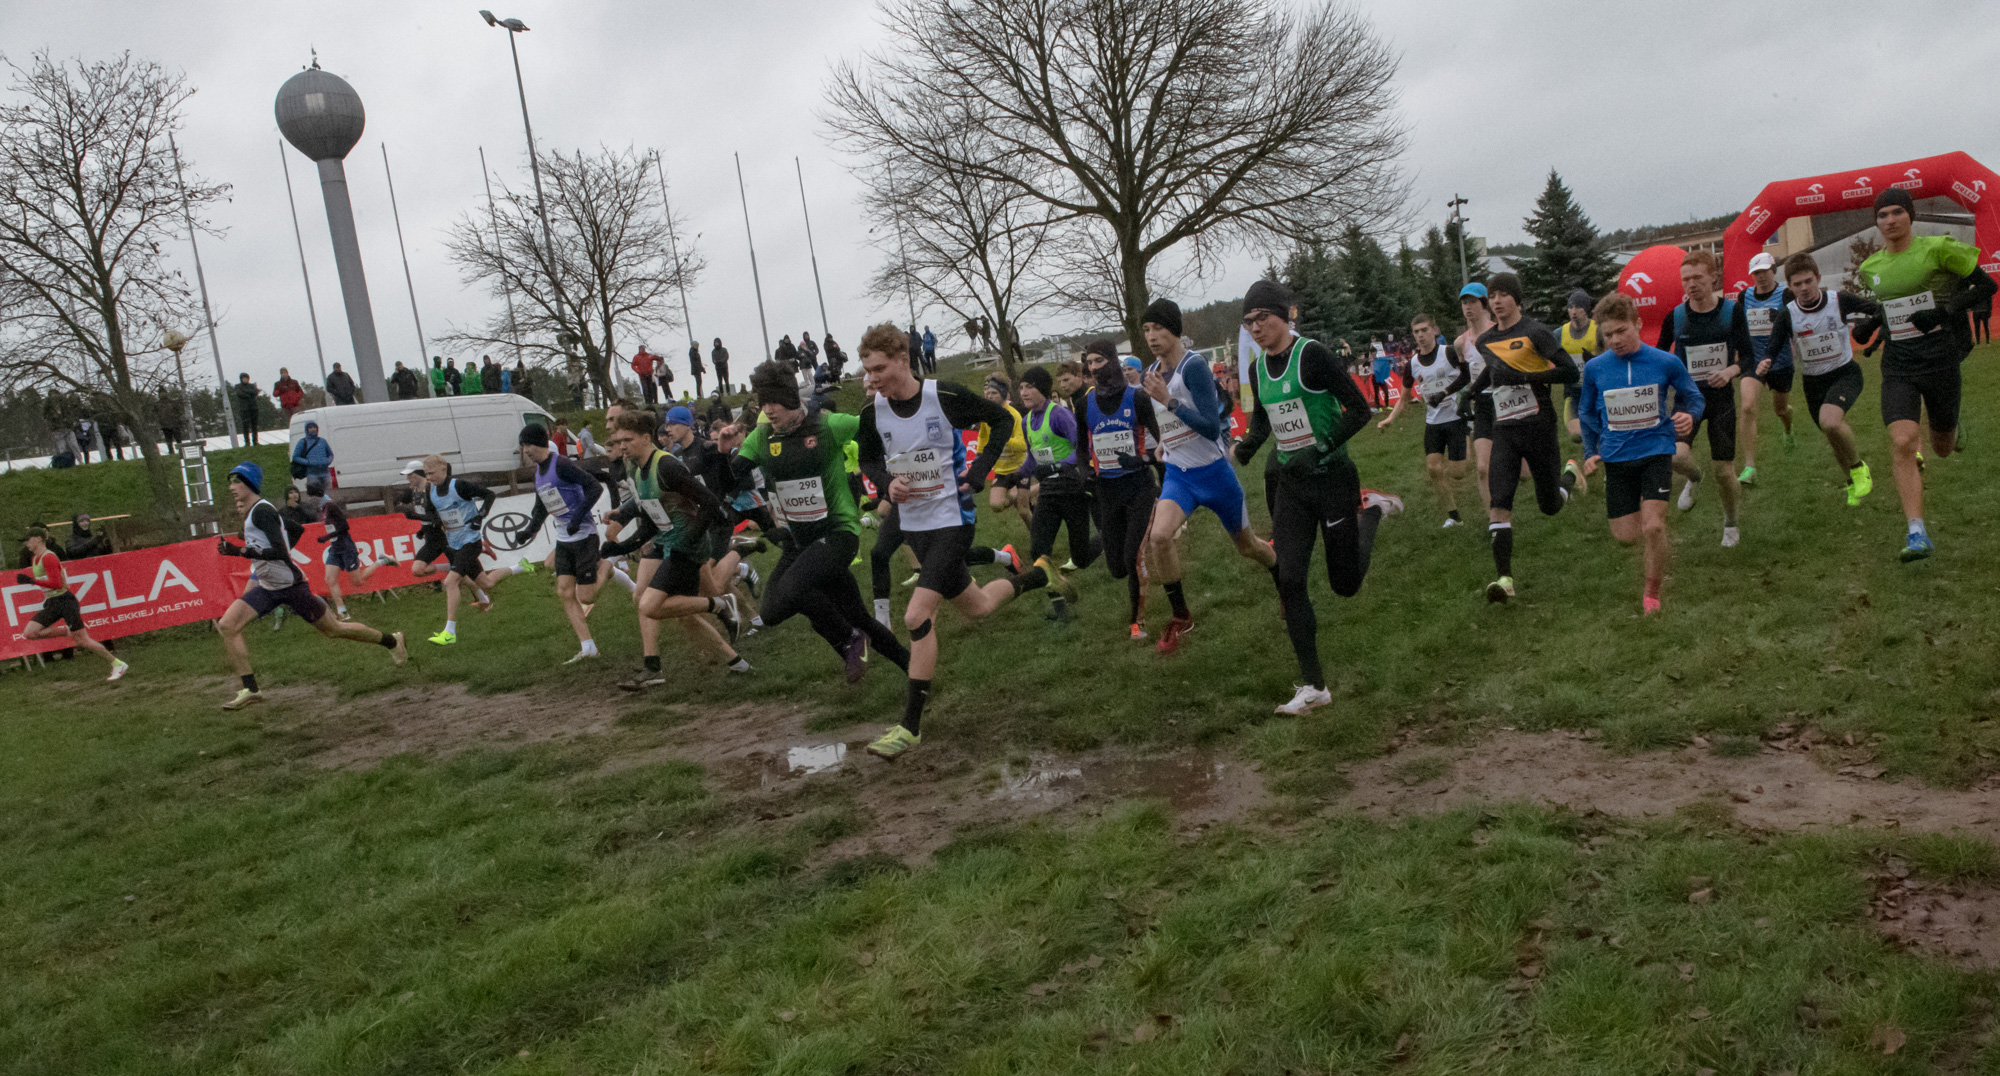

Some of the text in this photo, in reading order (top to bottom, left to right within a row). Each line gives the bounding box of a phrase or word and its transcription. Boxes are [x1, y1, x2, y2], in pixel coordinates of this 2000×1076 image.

[1843, 187, 1871, 198] ORLEN
[1954, 183, 1978, 201] ORLEN
[1797, 195, 1824, 204] ORLEN
[1748, 211, 1769, 233] ORLEN
[1981, 264, 2000, 272] ORLE
[1909, 295, 1928, 306] 162
[1819, 333, 1834, 342] 261
[1709, 345, 1725, 353] 347
[1807, 345, 1833, 356] ZELEK
[1691, 358, 1722, 368] BREZA
[1634, 388, 1653, 397] 548
[1279, 402, 1299, 414] 524
[1608, 402, 1656, 415] KALINOWSKI
[1115, 433, 1129, 441] 515
[914, 452, 935, 463] 484
[799, 480, 817, 490] 298
[784, 494, 817, 507] KOPEĆ
[1, 560, 199, 627] PZLA
[112, 609, 154, 623] LEKKIEJ
[157, 599, 203, 614] ATLETYKI
